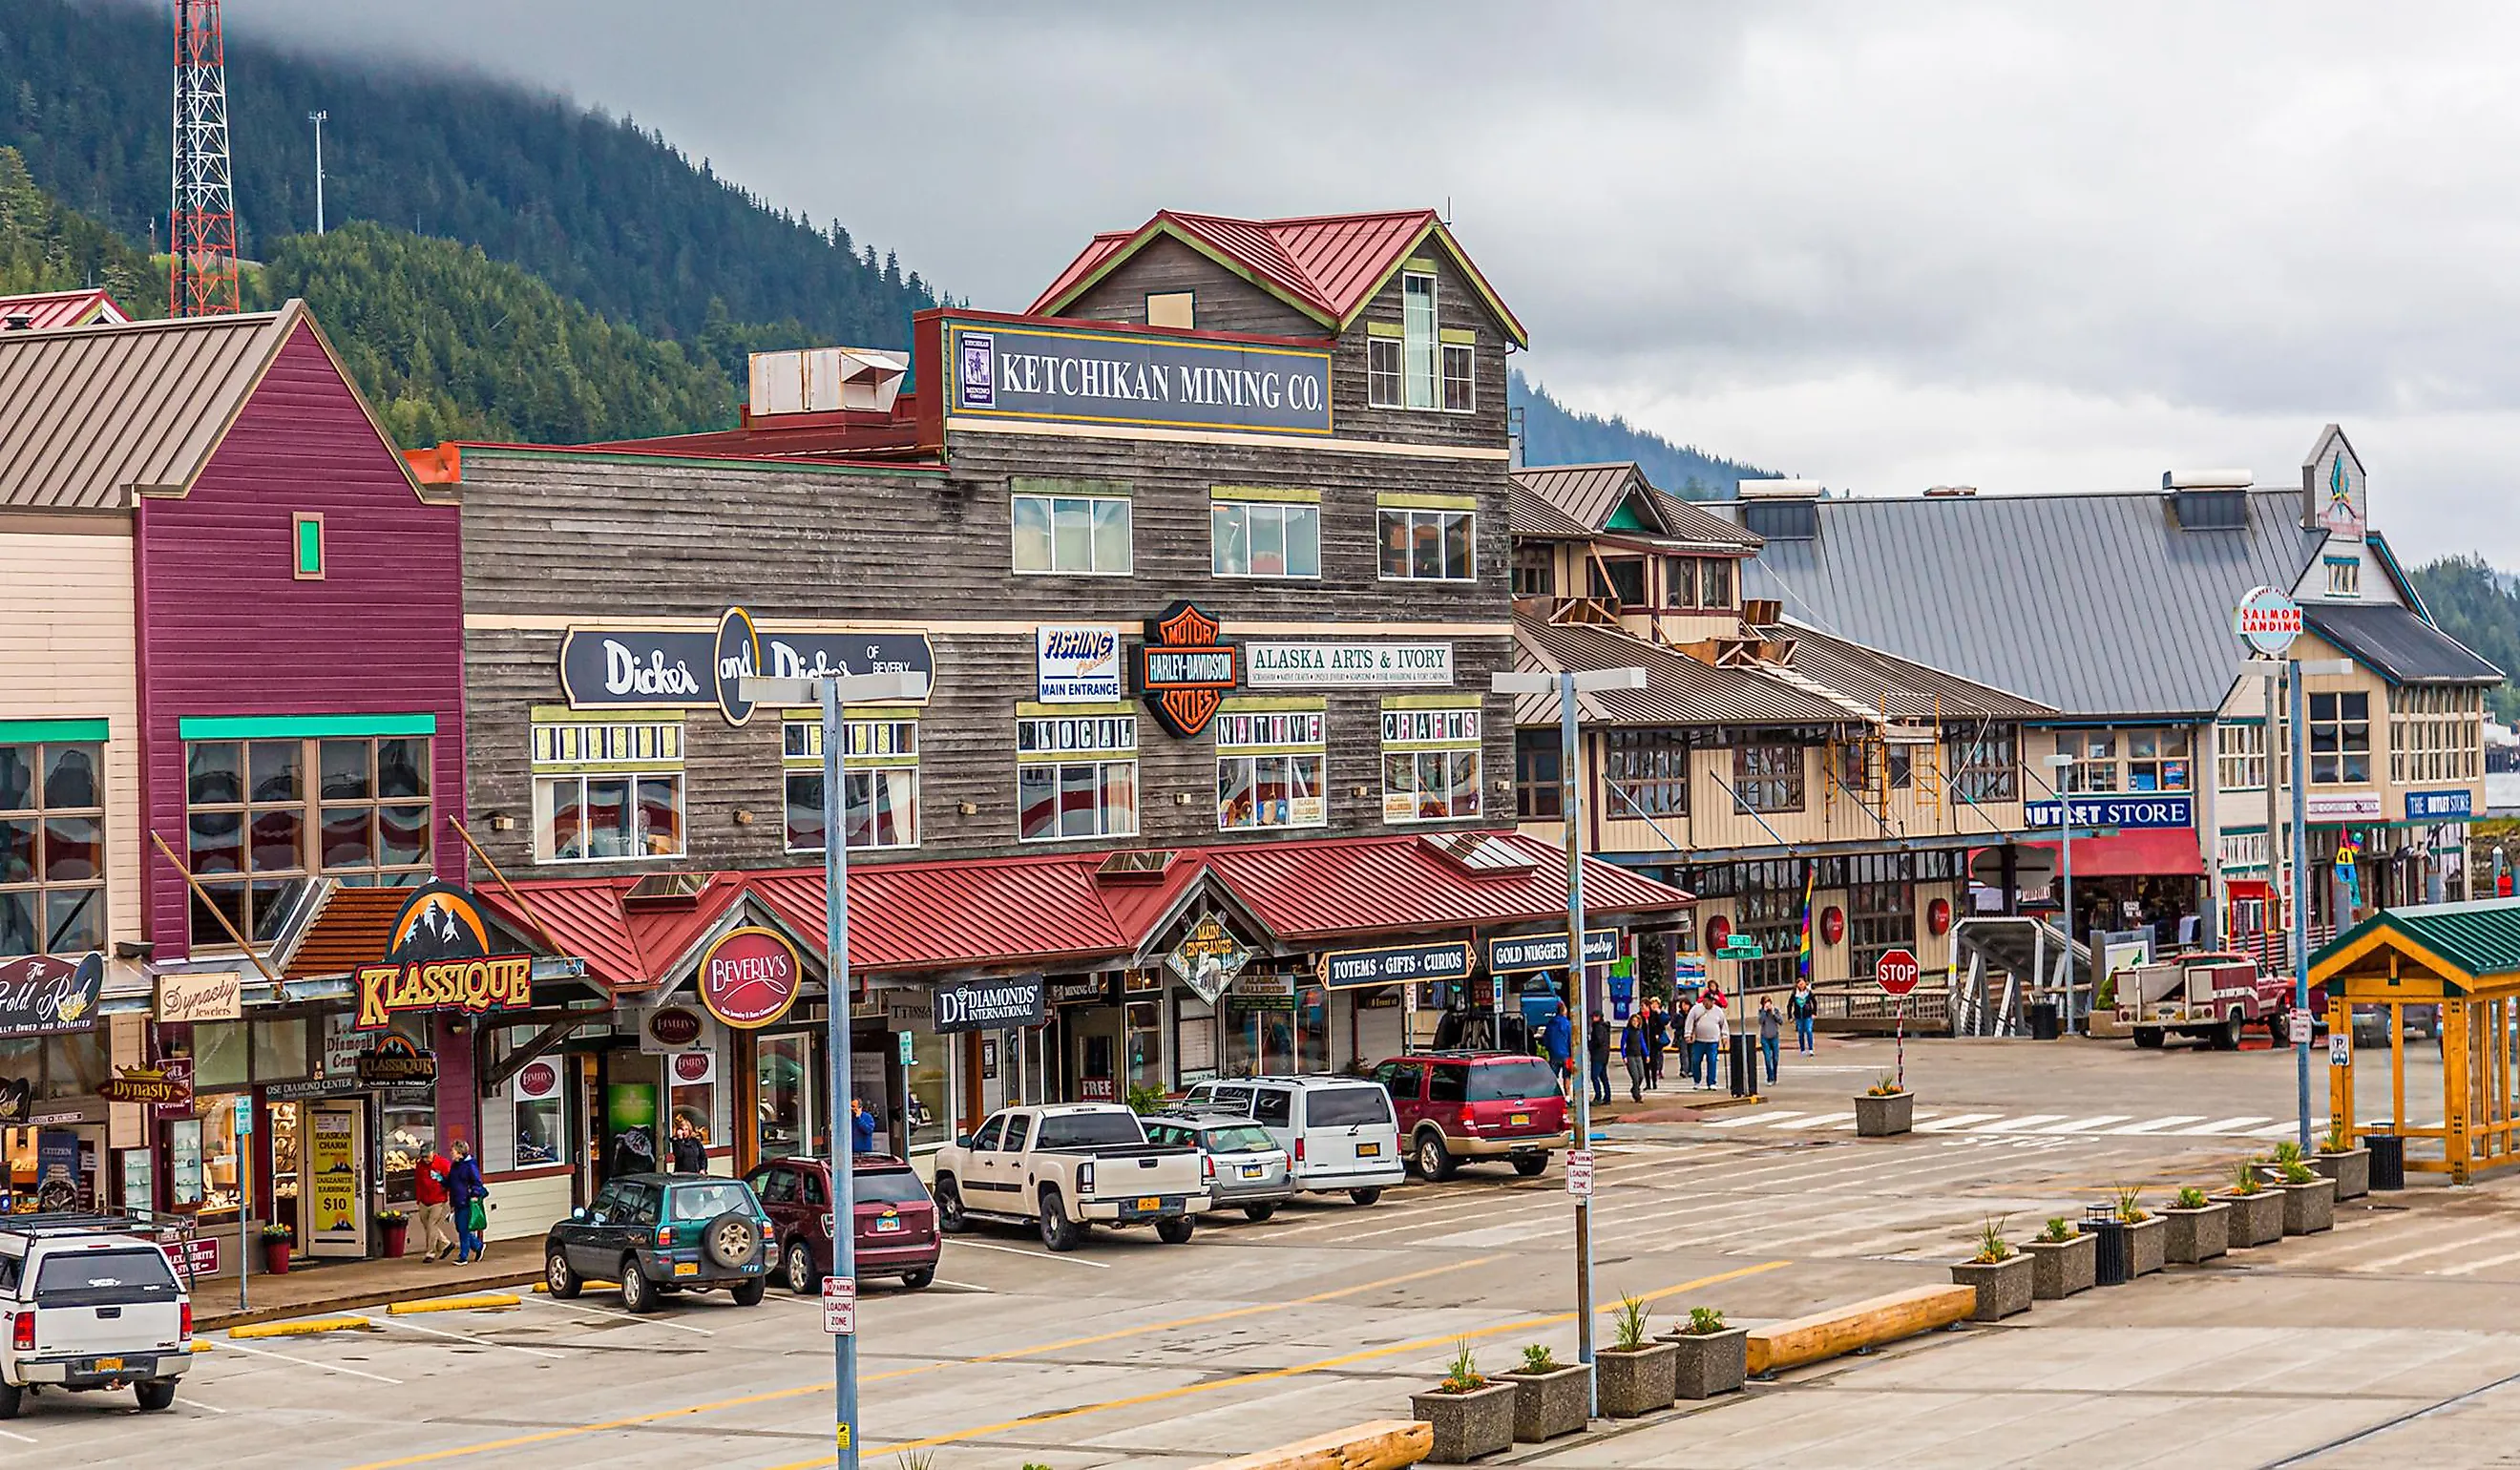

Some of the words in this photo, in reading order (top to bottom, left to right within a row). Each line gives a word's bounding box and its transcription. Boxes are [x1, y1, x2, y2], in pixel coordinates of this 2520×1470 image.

[1001, 352, 1170, 402] KETCHIKAN
[1179, 365, 1281, 410] MINING
[1288, 374, 1324, 411] CO.
[2242, 609, 2300, 620] SALMON
[1168, 616, 1211, 644] MOTOR
[2242, 621, 2301, 631] LANDING
[867, 645, 879, 659] OF
[1044, 630, 1114, 659] FISHING
[602, 639, 700, 695] Dicker
[720, 640, 755, 679] and
[872, 662, 911, 674] BEVERLY
[1149, 653, 1231, 682] HARLEY-DAVIDSON
[1254, 649, 1325, 668] ALASKA
[1332, 649, 1373, 668] ARTS
[1380, 651, 1391, 668] &
[1397, 649, 1446, 668] IVORY
[1041, 683, 1066, 696] MAIN
[1068, 683, 1119, 696] ENTRANCE
[1170, 689, 1212, 724] CYCLES
[1039, 721, 1131, 748] LOCAL
[1221, 716, 1320, 744] NATIVE
[1384, 713, 1476, 740] CRAFTS
[536, 726, 676, 759] ALASKA
[809, 724, 890, 755] FRS
[2410, 796, 2425, 814] THE
[2427, 795, 2449, 813] OUTLET
[2450, 794, 2470, 812] STORE
[2108, 804, 2186, 824] STORE
[1196, 924, 1221, 940] MAIN
[1186, 938, 1232, 957] ENTRANCE
[1496, 946, 1522, 964] GOLD
[1524, 942, 1567, 962] NUGGETS
[1584, 934, 1614, 959] ewelry
[26, 961, 46, 984] The
[712, 954, 788, 993] BEVERLY'S
[1334, 957, 1376, 979] TOTEMS
[1385, 955, 1417, 975] GIFTS
[1423, 951, 1463, 971] CURIOS
[1880, 964, 1917, 982] STOP
[36, 973, 93, 1021] Rush
[164, 978, 239, 1018] Dynasty
[359, 958, 531, 1026] KLASSIQUE
[1064, 985, 1086, 997] MINING
[194, 1007, 232, 1018] Jewelers
[969, 1004, 1033, 1021] INTERNATIONAL
[41, 1021, 54, 1030] AND
[56, 1019, 91, 1030] OPERATED
[359, 1058, 433, 1077] KLASSIQUE
[113, 1080, 174, 1102] Dynasty
[266, 1084, 282, 1096] OSE
[284, 1080, 321, 1093] DIAMOND
[322, 1078, 352, 1089] CENTER
[1082, 1080, 1112, 1097] FREE
[316, 1132, 351, 1141] ALASKAN
[319, 1141, 348, 1150] CHARM
[42, 1147, 73, 1156] CITIZEN
[323, 1197, 346, 1211] $10
[179, 1244, 199, 1254] YUR
[826, 1302, 851, 1312] LOADING
[830, 1316, 847, 1326] ZONE
